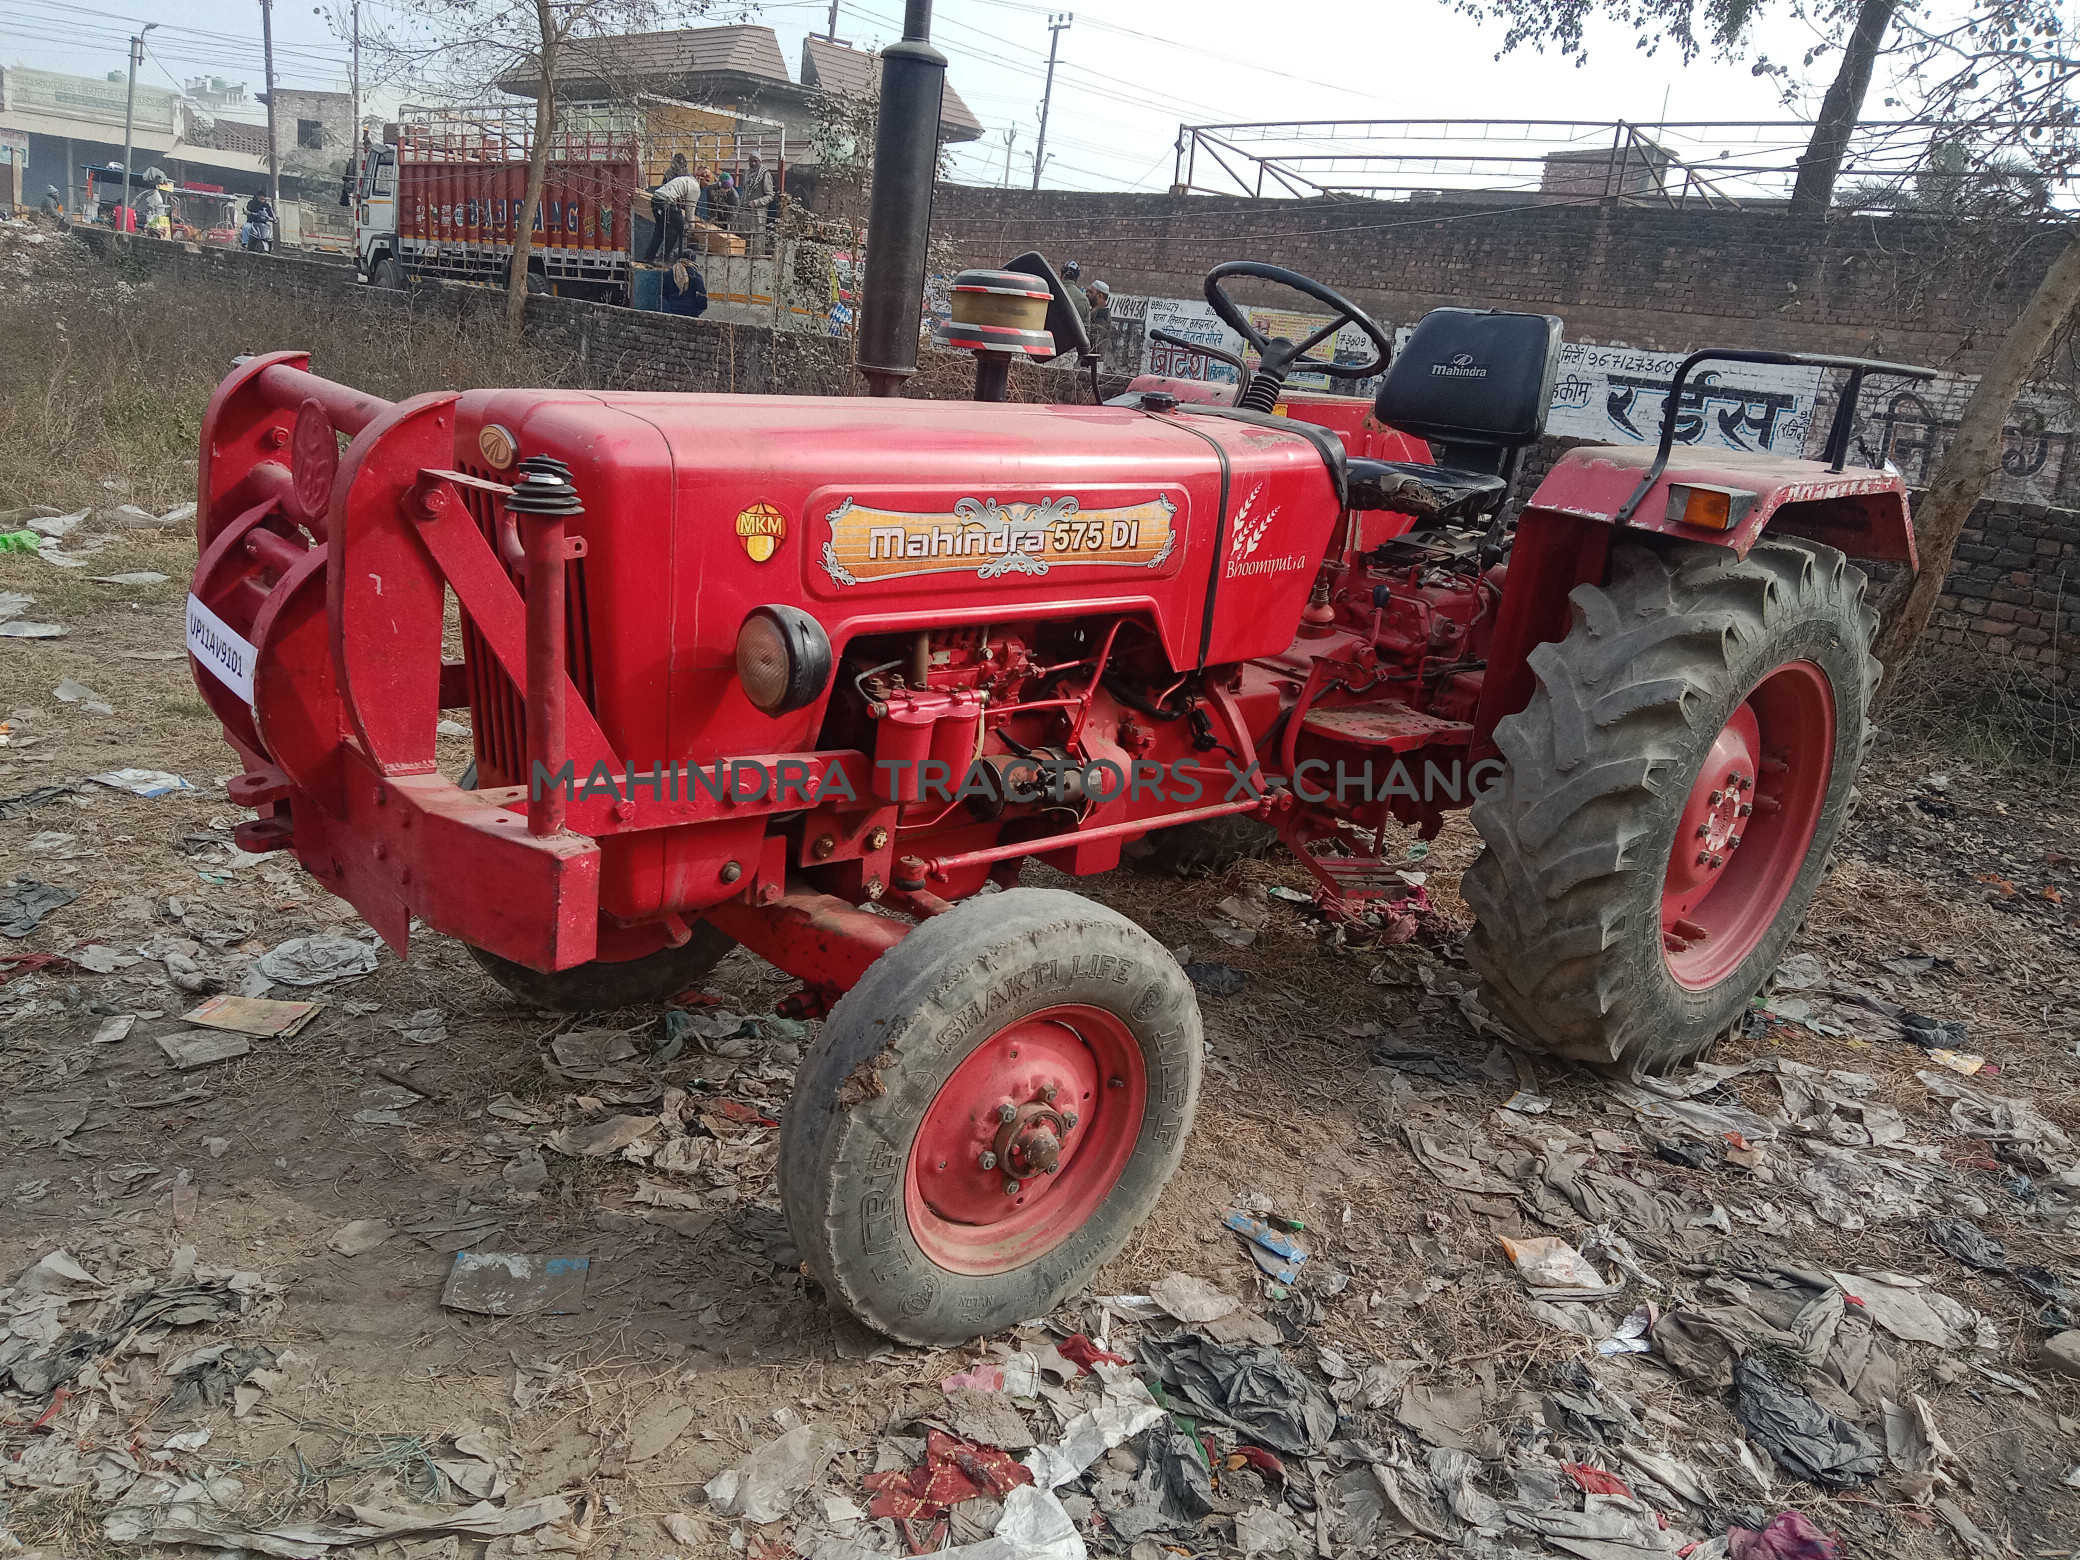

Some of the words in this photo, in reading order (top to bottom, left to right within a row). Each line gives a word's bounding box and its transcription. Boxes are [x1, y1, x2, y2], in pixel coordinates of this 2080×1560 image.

[1431, 364, 1487, 378] Mahindra
[739, 513, 783, 536] MKM
[867, 523, 1047, 560] Mahindra
[1051, 521, 1104, 551] 575
[1110, 520, 1139, 549] DI
[189, 612, 244, 679] UP11AV9101
[935, 959, 1059, 1053] SHAKTI
[1070, 954, 1134, 985] LIFE
